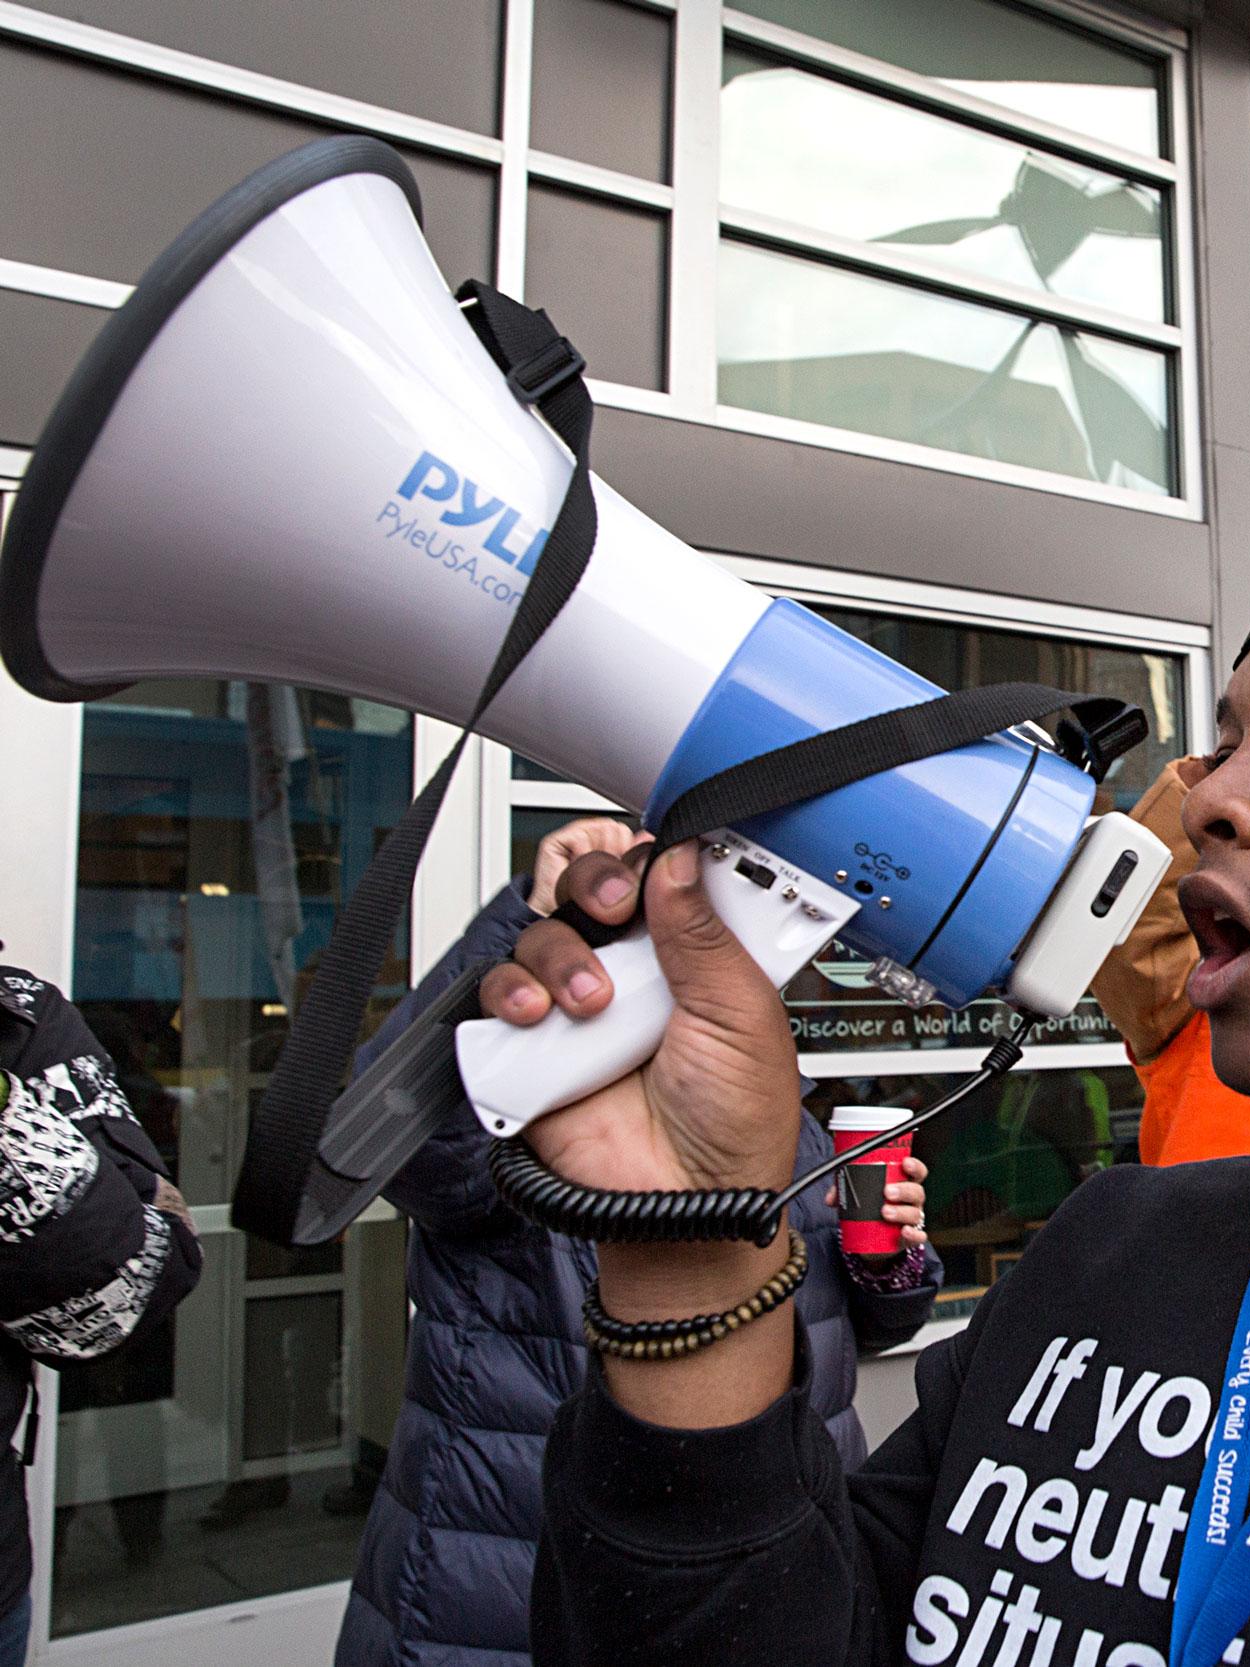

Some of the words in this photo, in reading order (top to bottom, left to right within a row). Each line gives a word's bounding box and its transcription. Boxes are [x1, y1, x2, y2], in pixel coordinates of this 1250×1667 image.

[777, 865, 801, 883] TALK
[788, 1016, 886, 1038] Discover
[891, 1018, 906, 1036] a
[913, 1010, 971, 1035] World
[978, 1012, 1002, 1037] of
[1006, 1336, 1099, 1433] If
[1222, 1394, 1247, 1441] Child
[1206, 1449, 1238, 1546] Succeeds!
